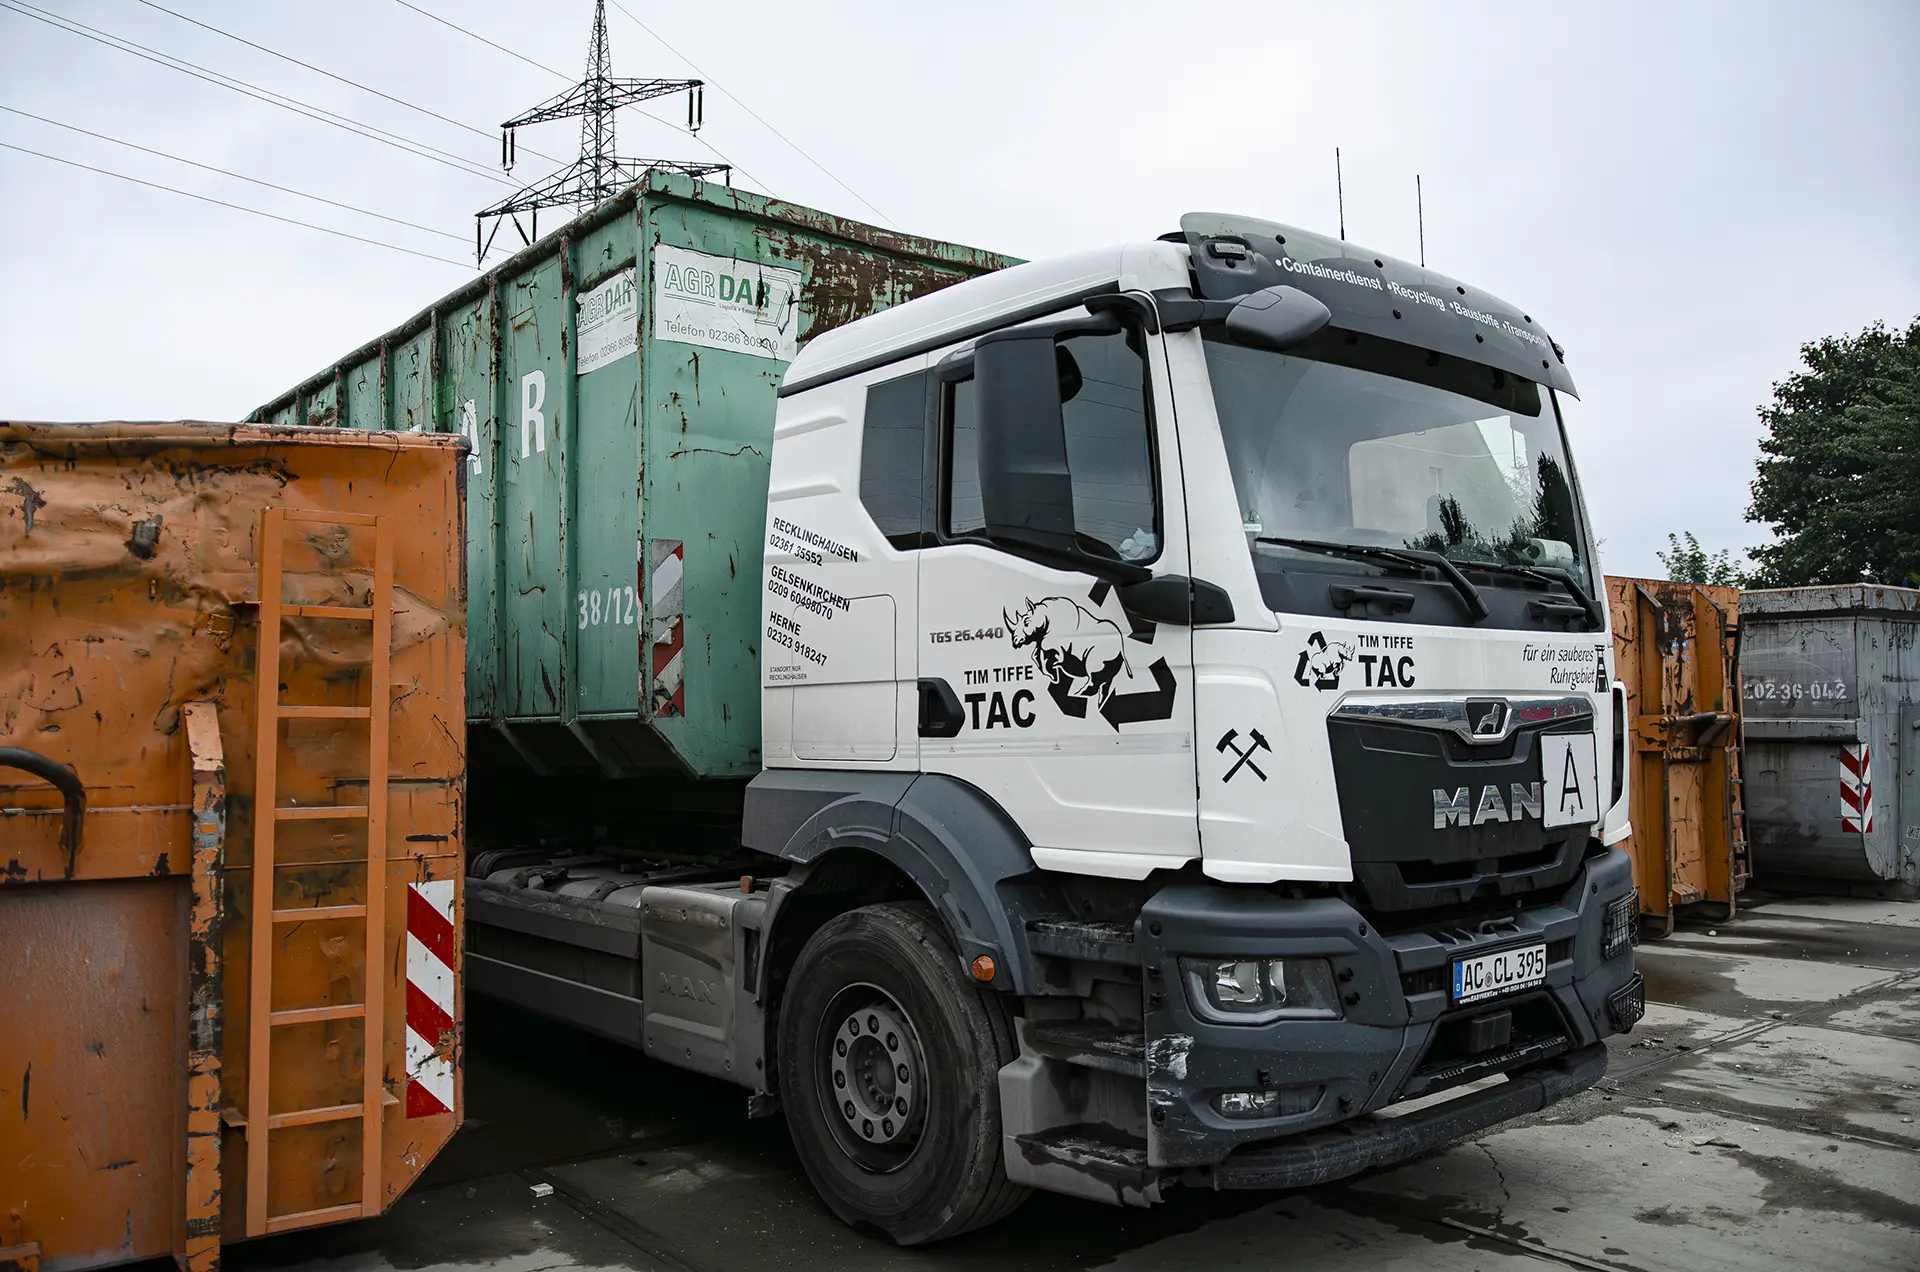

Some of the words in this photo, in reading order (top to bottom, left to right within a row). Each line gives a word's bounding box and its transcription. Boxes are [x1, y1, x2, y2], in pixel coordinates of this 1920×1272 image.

[664, 263, 716, 298] AGR
[664, 320, 705, 338] Telefon
[708, 328, 741, 344] 02366
[577, 352, 599, 368] Telefon
[600, 340, 618, 358] 02366
[522, 369, 546, 459] R
[769, 534, 794, 554] 02361
[794, 547, 823, 567] 35552
[773, 517, 858, 563] RECKLINGHAUSEN
[768, 579, 789, 598] 0209
[790, 590, 833, 620] 60498070
[771, 565, 851, 612] GELSENKIRCHEN
[578, 586, 634, 630] 38/12
[769, 611, 802, 636] HERNE
[767, 626, 793, 649] 02323
[794, 640, 828, 667] 918247
[930, 631, 952, 643] TGS
[954, 627, 1004, 642] 26.440
[1357, 634, 1380, 648] TIM
[1382, 635, 1414, 650] TIFFE
[1522, 644, 1539, 661] für
[1540, 643, 1556, 662] ein
[1557, 645, 1594, 662] sauberes
[964, 667, 989, 685] TIM
[993, 665, 1034, 683] TIFFE
[1358, 655, 1416, 688] TAC
[1549, 666, 1595, 691] Ruhrgebiet
[964, 689, 1036, 730] TAC
[1559, 744, 1584, 814] A
[1432, 781, 1542, 830] MAN
[1463, 961, 1484, 992] AC
[1494, 956, 1513, 984] CL
[1517, 949, 1544, 979] 395
